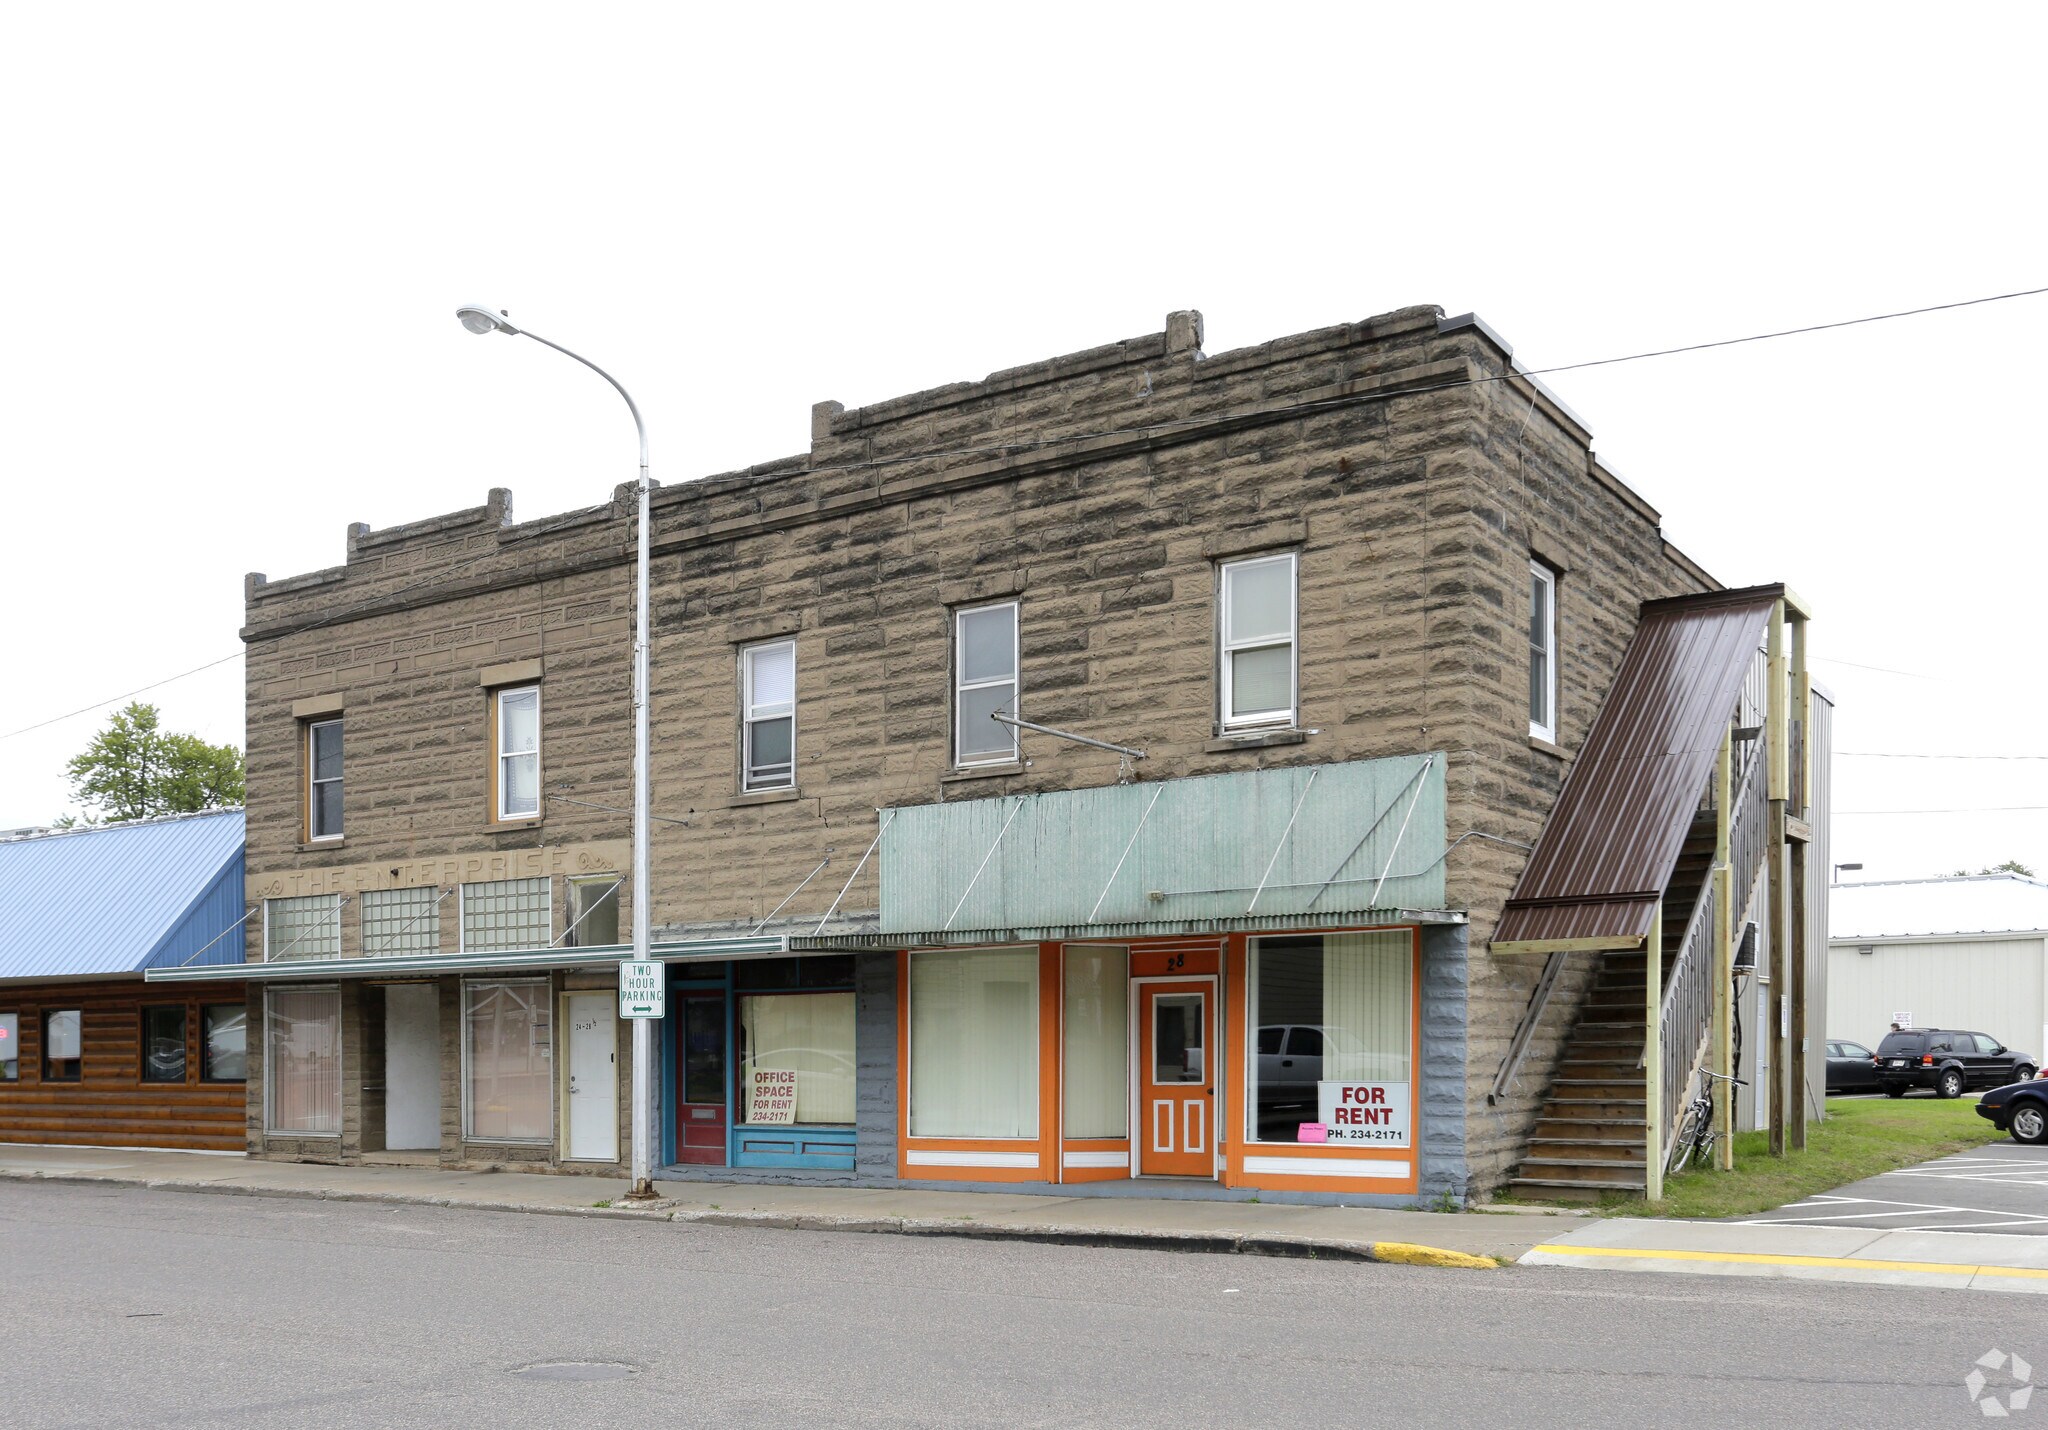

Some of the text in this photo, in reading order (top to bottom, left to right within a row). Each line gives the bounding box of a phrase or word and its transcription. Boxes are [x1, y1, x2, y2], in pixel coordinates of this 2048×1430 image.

[289, 849, 568, 896] THE ENTERPRISE
[1167, 953, 1184, 971] 28
[632, 965, 651, 976] TWO
[629, 978, 655, 988] HOUR
[622, 991, 662, 1001] PARKING
[754, 1072, 795, 1083] OFFICE
[755, 1086, 793, 1097] SPACE
[1341, 1086, 1385, 1104] FOR
[753, 1100, 793, 1109] FOR RENT
[752, 1112, 788, 1121] 234-2171
[1335, 1107, 1393, 1125] RENT
[1327, 1130, 1402, 1139] PH. 234-2171
